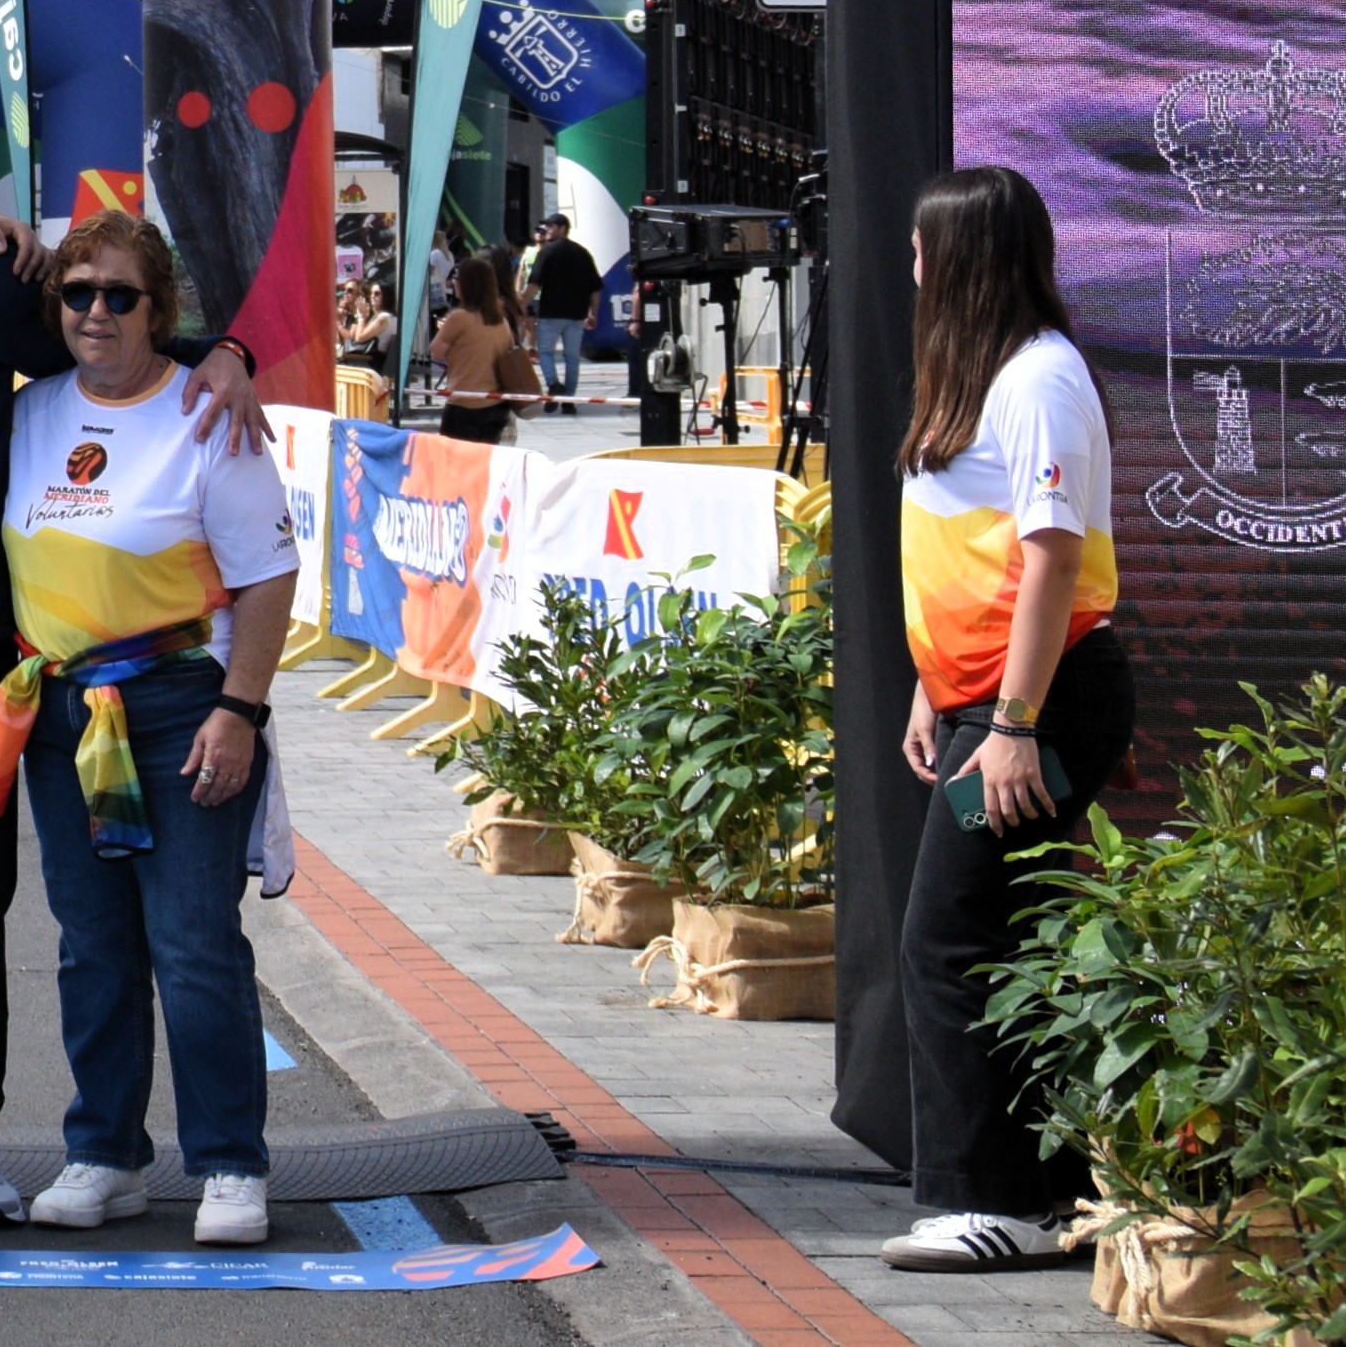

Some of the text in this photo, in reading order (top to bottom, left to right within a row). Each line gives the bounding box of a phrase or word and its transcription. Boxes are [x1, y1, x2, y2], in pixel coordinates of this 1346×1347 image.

[501, 9, 592, 102] CABILDO EL HIERRO
[451, 150, 493, 162] jasiete
[47, 485, 111, 496] MARATÓN DEL
[43, 492, 110, 504] MERIDIANO
[1215, 510, 1346, 543] OCCIDENT
